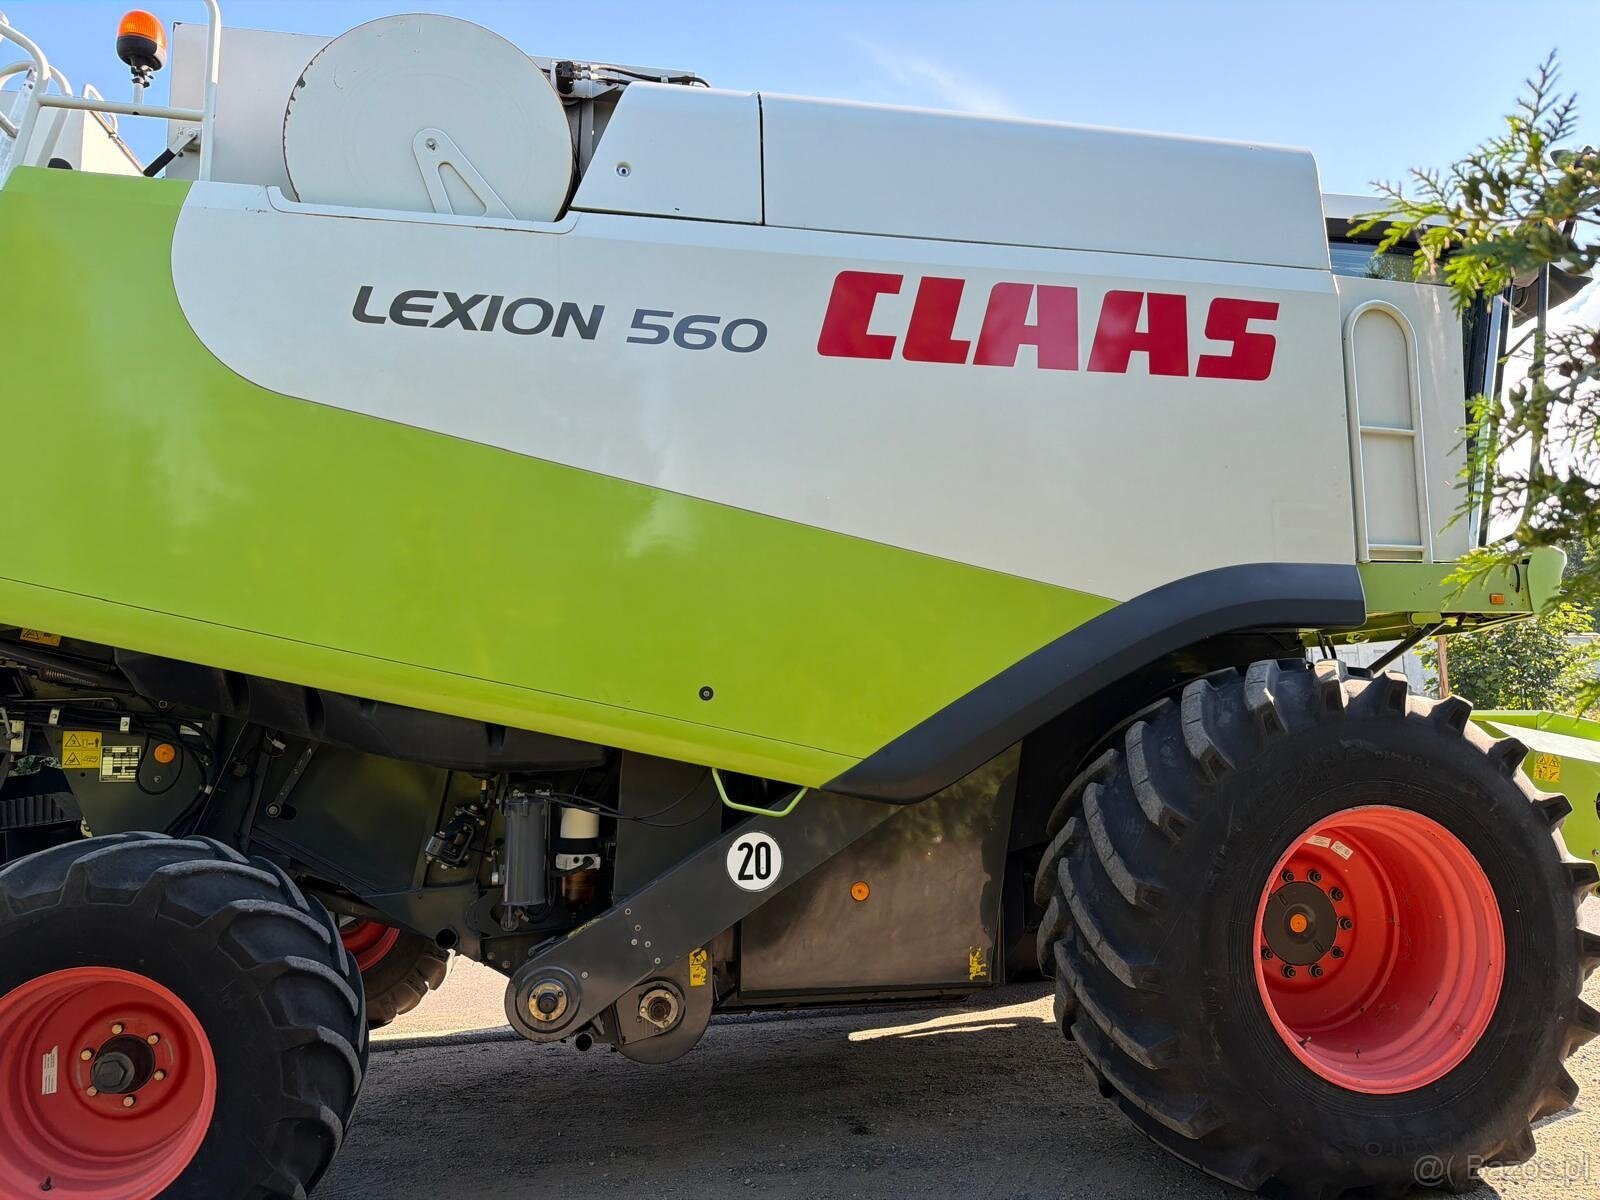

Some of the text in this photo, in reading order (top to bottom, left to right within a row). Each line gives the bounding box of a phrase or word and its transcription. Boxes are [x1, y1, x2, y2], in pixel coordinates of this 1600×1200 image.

[352, 285, 768, 353] LEXION 560
[817, 270, 1280, 381] CLAAS
[737, 841, 771, 881] 20
